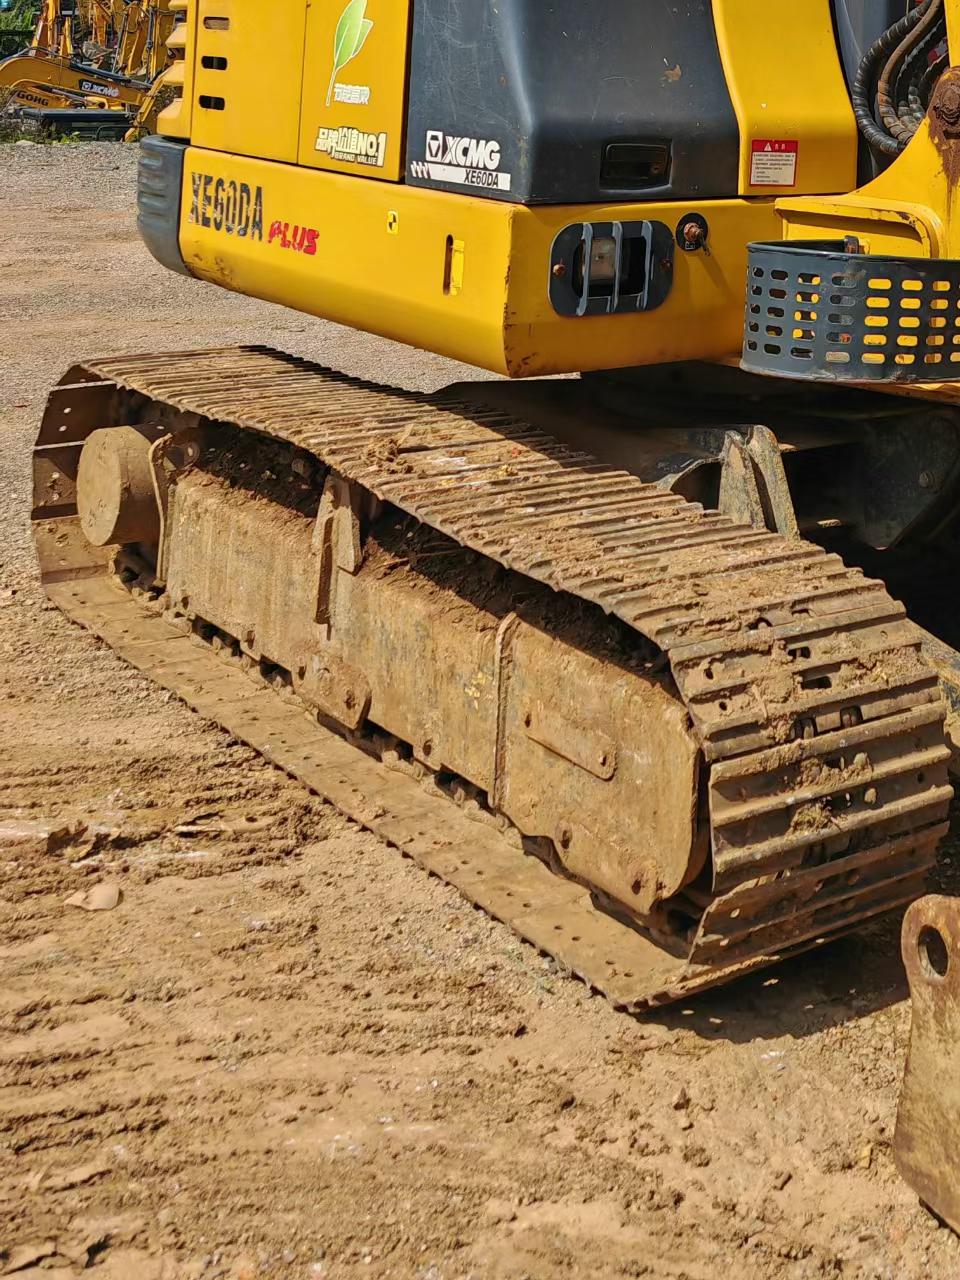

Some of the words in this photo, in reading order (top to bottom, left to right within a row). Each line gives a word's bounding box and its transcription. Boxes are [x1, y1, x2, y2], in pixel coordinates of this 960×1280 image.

[334, 151, 356, 162] BRAND
[357, 154, 378, 165] VALUE
[441, 135, 501, 170] XCMG
[464, 168, 499, 188] XE60DA
[188, 171, 263, 242] XE60DA
[267, 220, 320, 256] PLUS
